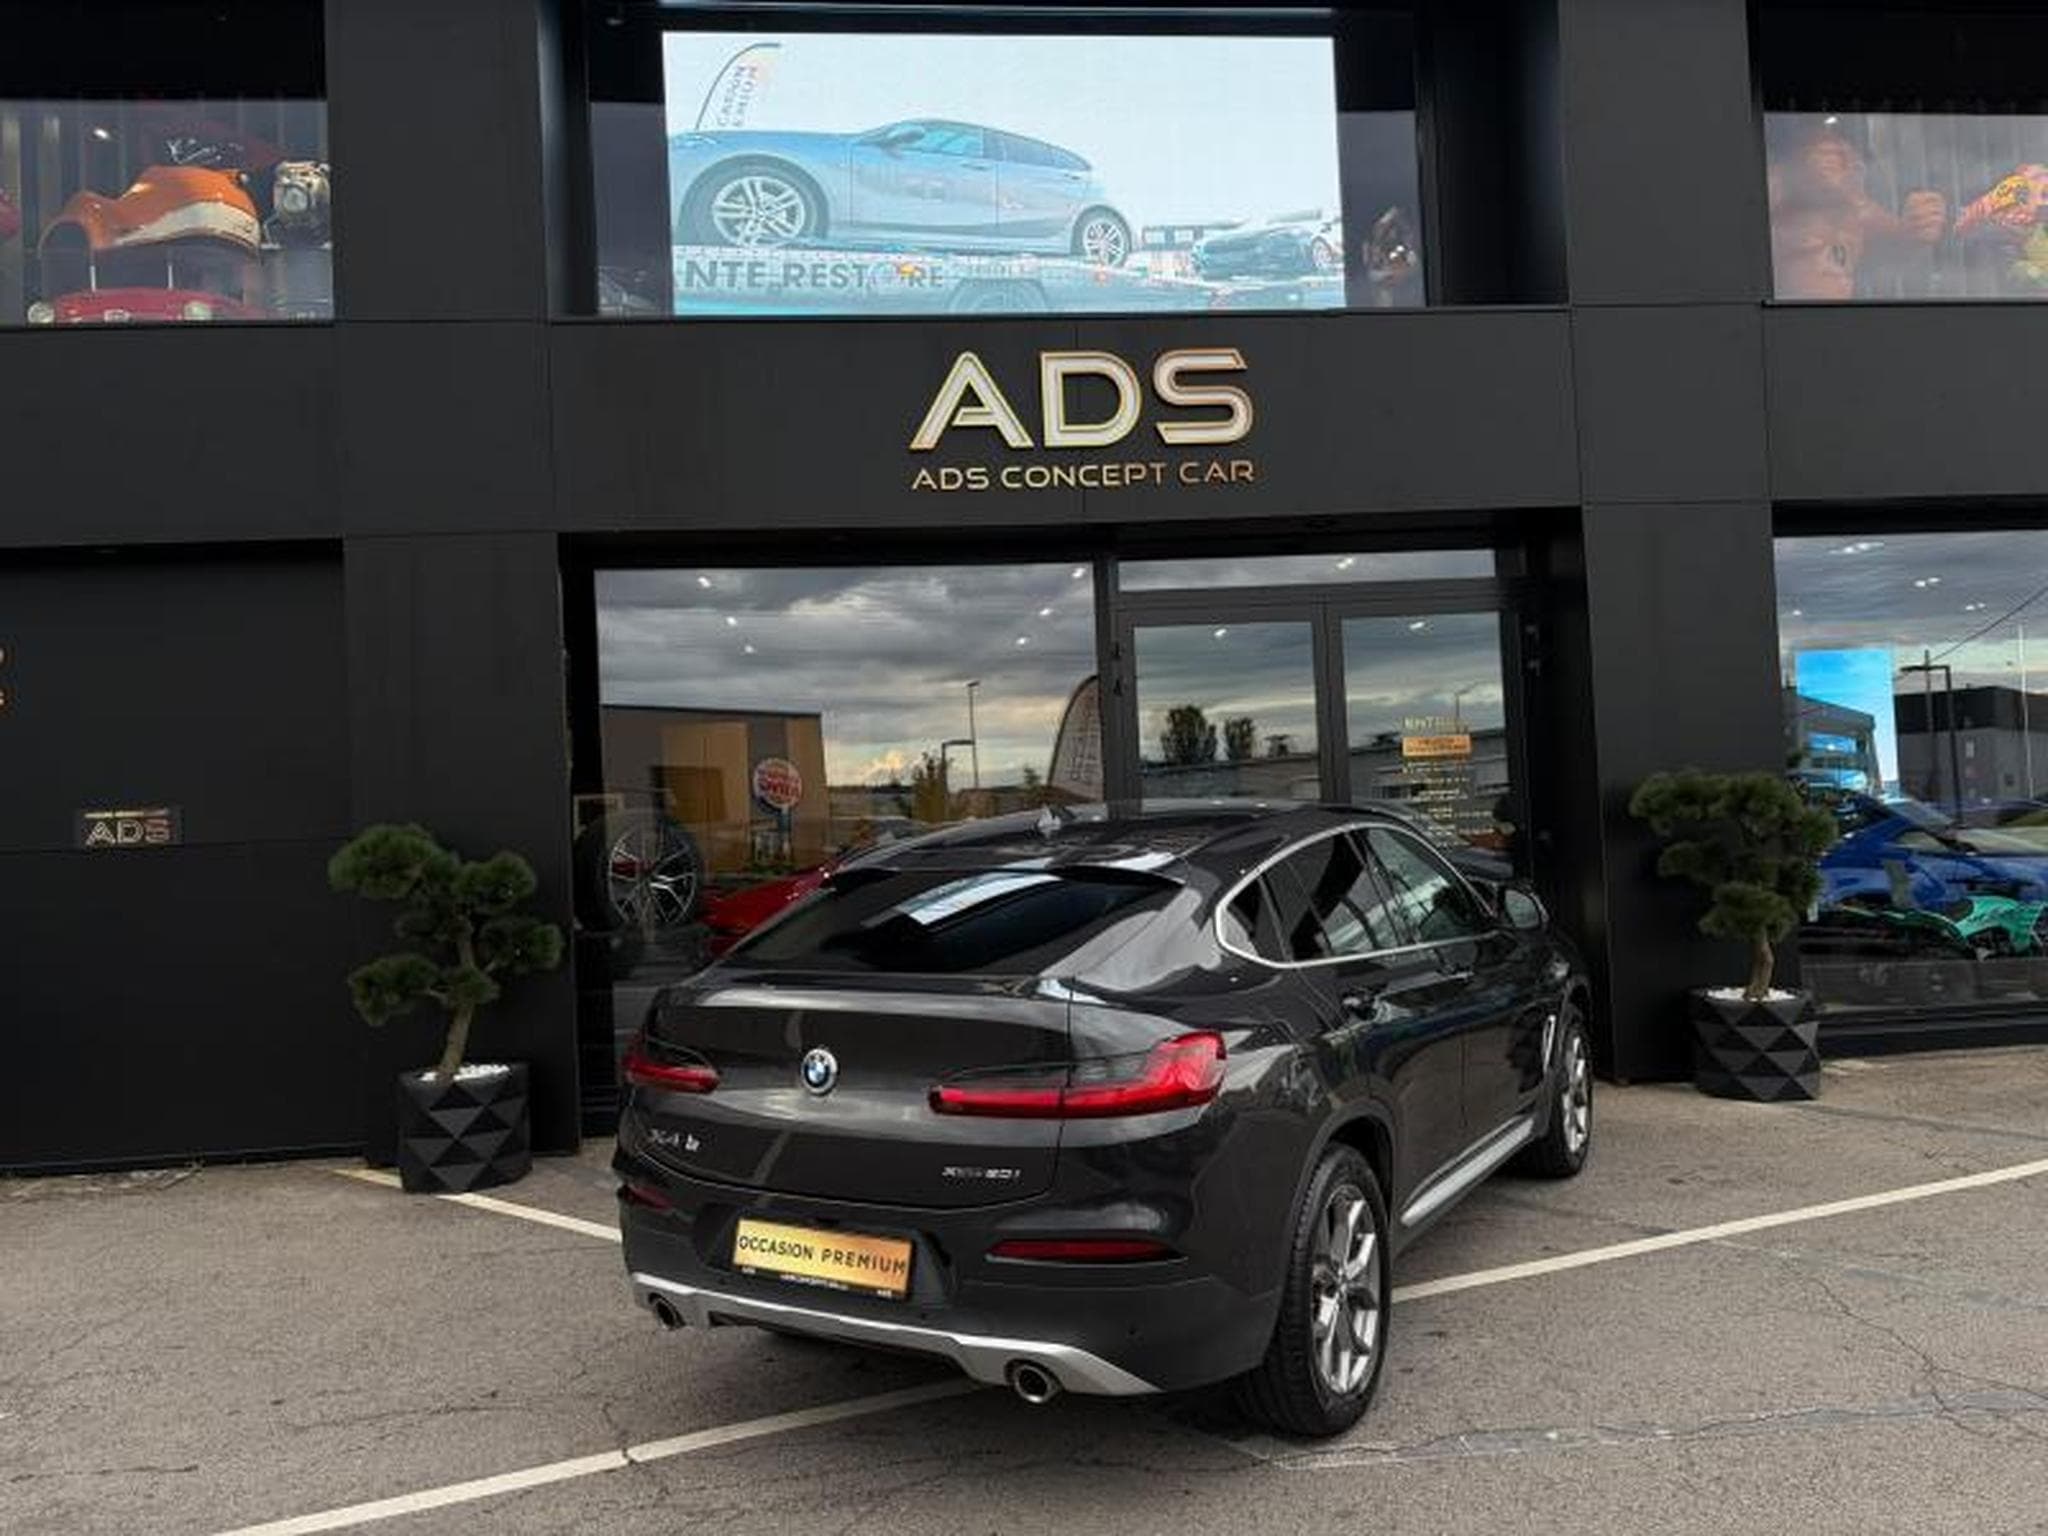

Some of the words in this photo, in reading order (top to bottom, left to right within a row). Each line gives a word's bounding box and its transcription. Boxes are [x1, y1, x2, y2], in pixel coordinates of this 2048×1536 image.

[908, 347, 1255, 451] ADS
[911, 466, 990, 491] ADS
[1000, 462, 1167, 489] CONCEPT
[1178, 459, 1255, 483] CAR
[85, 819, 170, 846] ADS
[738, 1235, 815, 1261] OCCASION
[820, 1248, 907, 1275] PREMIUM
